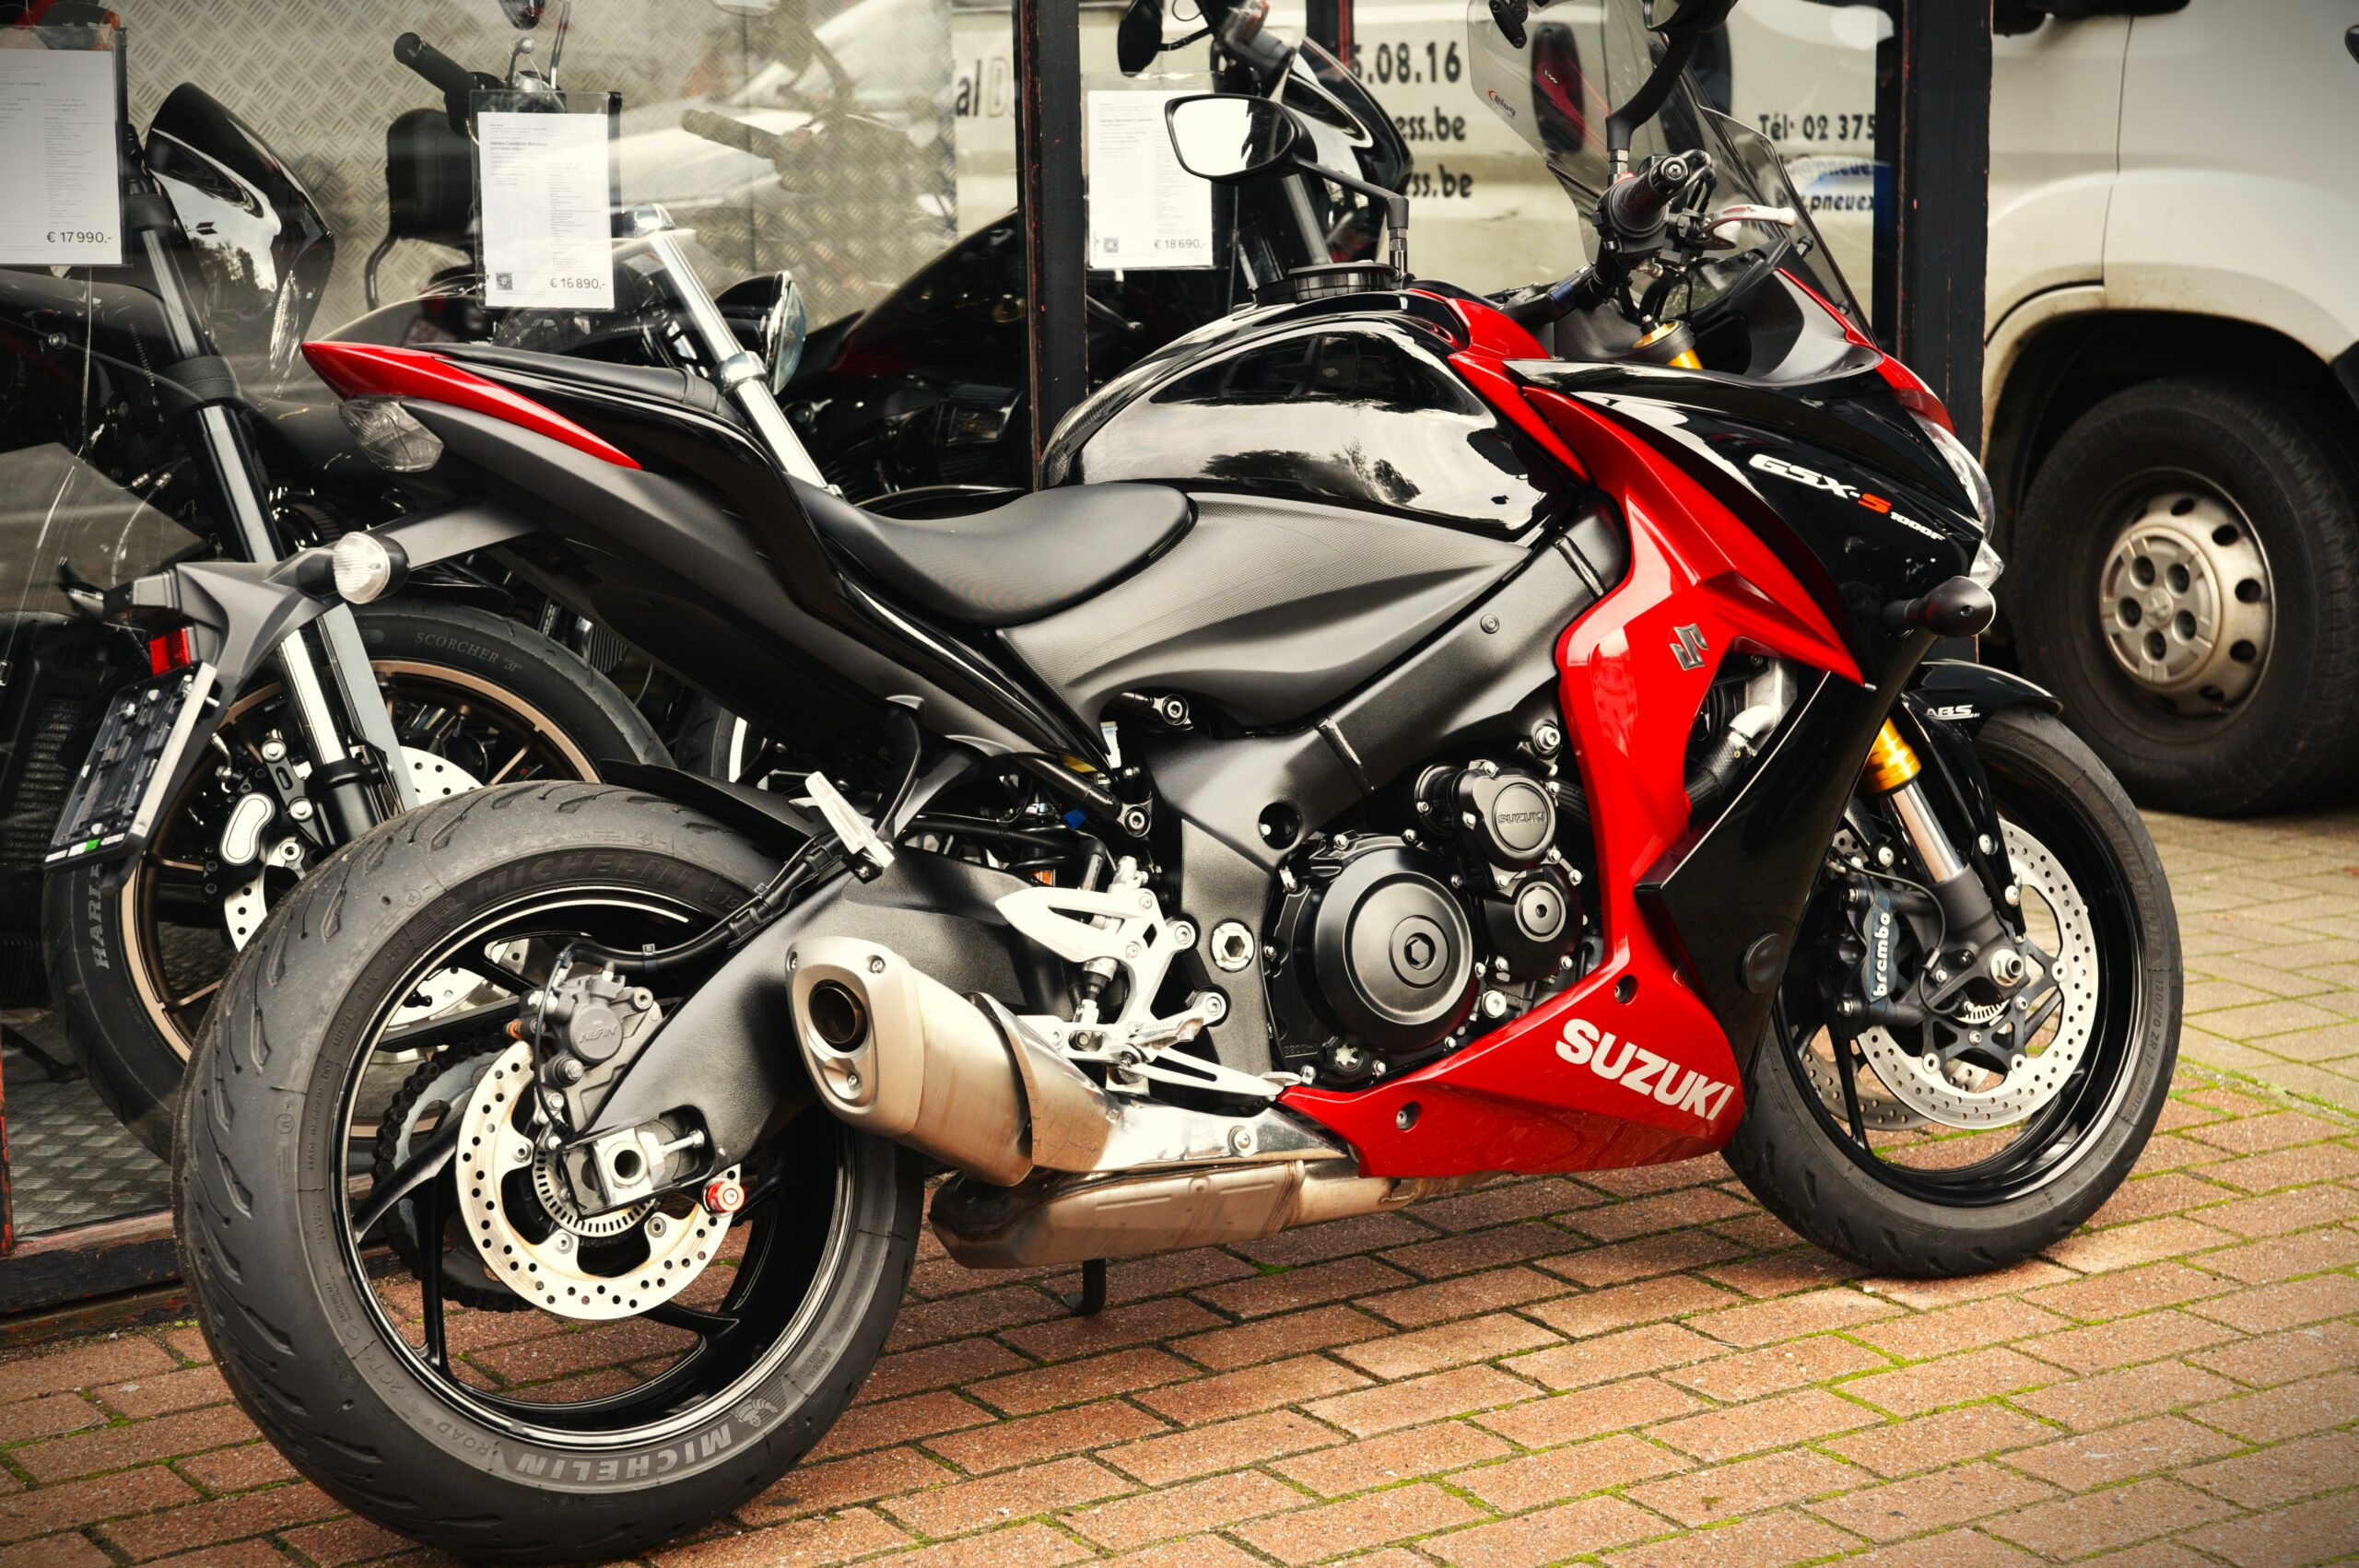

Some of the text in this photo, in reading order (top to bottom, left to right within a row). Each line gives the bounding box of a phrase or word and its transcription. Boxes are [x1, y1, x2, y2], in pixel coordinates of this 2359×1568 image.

[1802, 114, 1829, 141] 02
[1749, 453, 1945, 541] GSX-S 1000F
[416, 632, 499, 664] SCORCHER
[1926, 704, 1974, 719] ABS
[1497, 811, 1545, 825] SUZUKI
[475, 853, 693, 902] MICHELIN
[1872, 912, 1890, 997] brembo
[2153, 979, 2165, 1028] 120/70
[2148, 1032, 2161, 1050] ZR
[1555, 1018, 1735, 1121] SUZUKI
[2146, 1053, 2155, 1070] 17
[311, 1124, 318, 1135] IN
[437, 1421, 491, 1457] ROAD
[515, 1422, 733, 1481] MICHELIN
